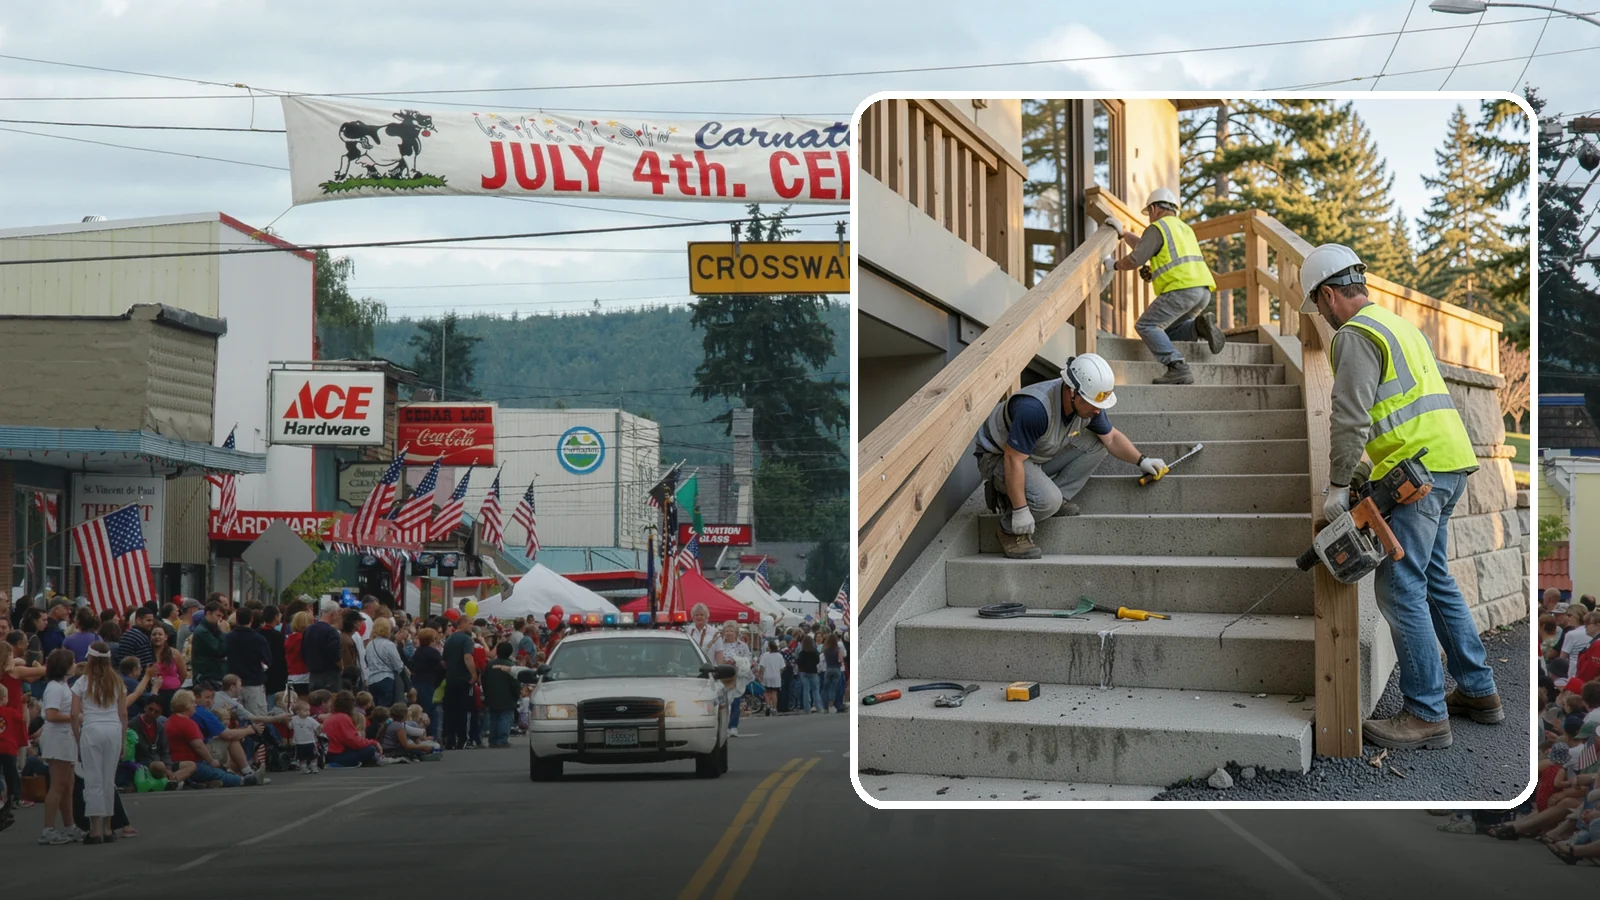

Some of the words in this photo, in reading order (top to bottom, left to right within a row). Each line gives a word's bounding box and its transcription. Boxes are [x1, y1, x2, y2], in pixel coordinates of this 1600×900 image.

[695, 122, 850, 150] Carnat
[481, 141, 605, 192] JULY
[632, 150, 746, 197] 4th.
[697, 255, 850, 280] CROSSWA
[283, 380, 373, 420] ACE
[405, 409, 452, 422] CEDAR
[461, 409, 485, 422] LOG
[283, 421, 370, 436] Hardware
[416, 428, 477, 447] Coca-Cola
[83, 485, 93, 494] St.
[96, 485, 124, 495] Vincent
[127, 485, 135, 495] de
[138, 486, 155, 495] Paul
[81, 503, 154, 522] THRT
[213, 516, 330, 536] HARDARE
[688, 526, 741, 535] CRNATION
[699, 535, 730, 543] GLASS
